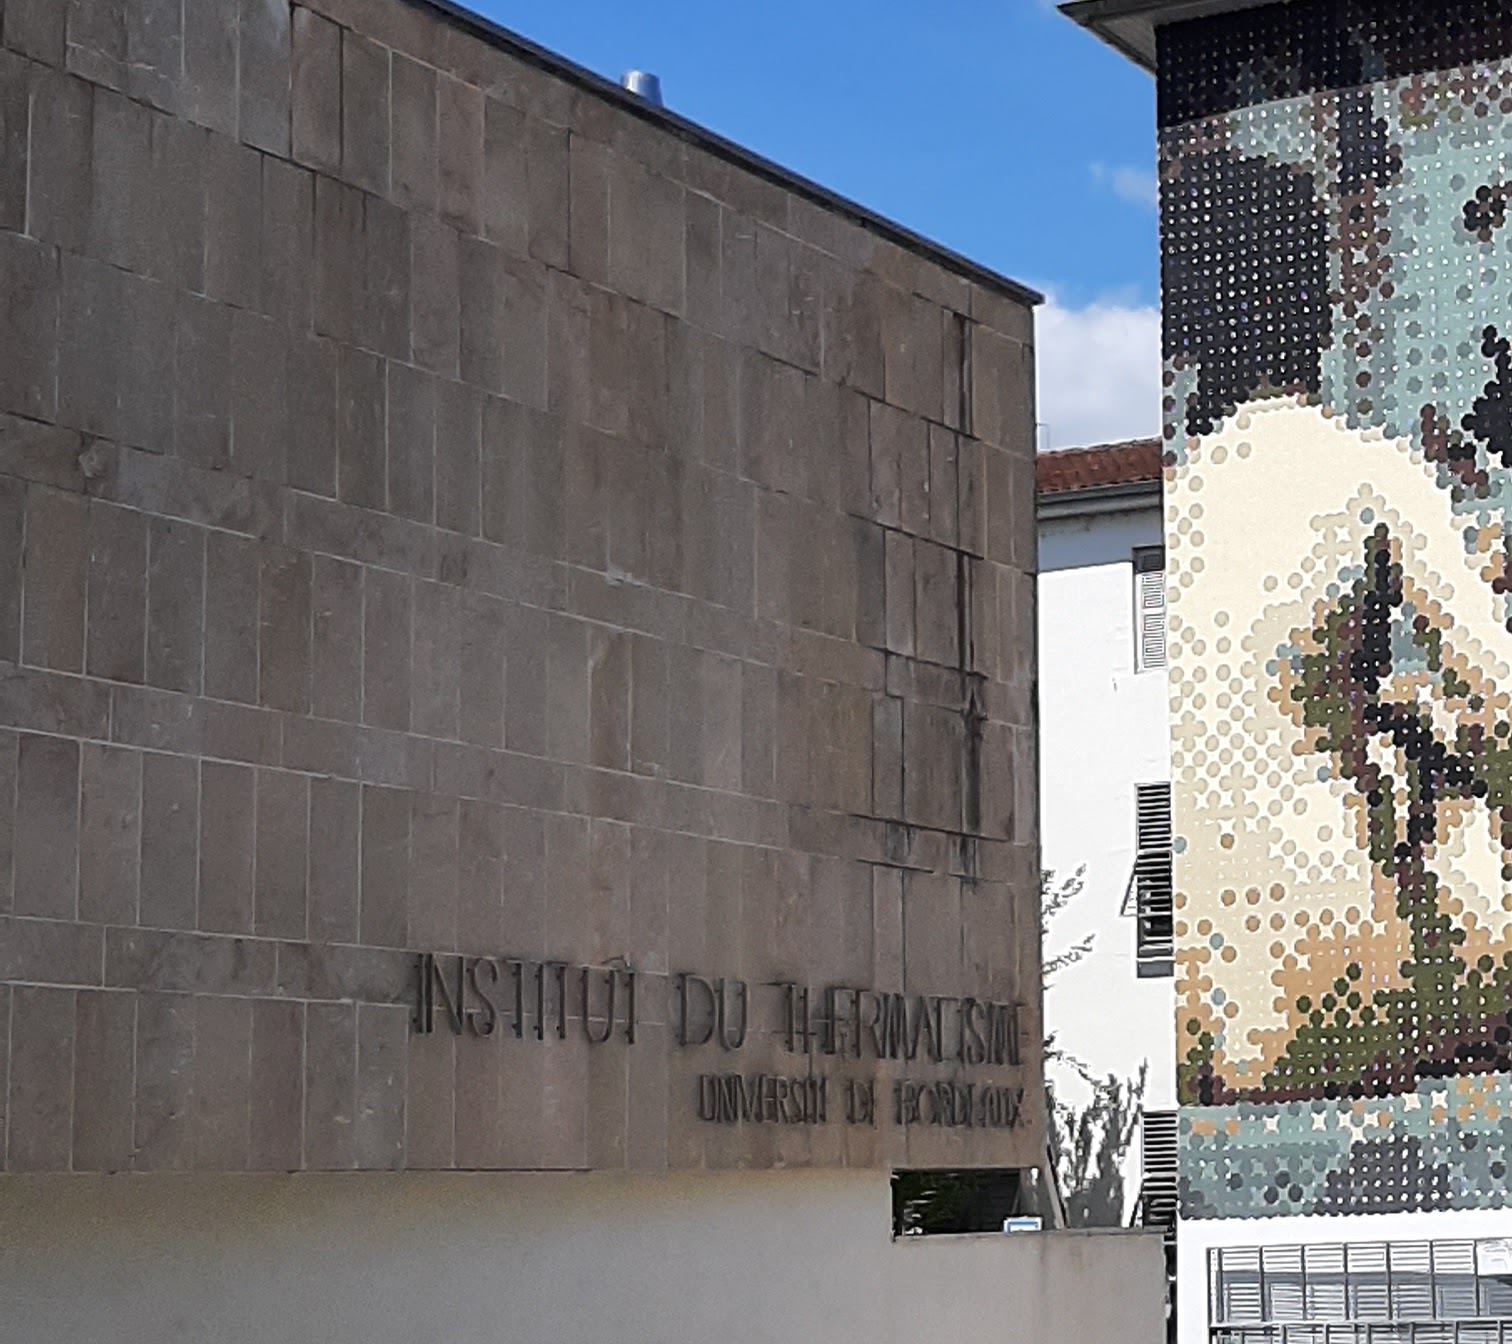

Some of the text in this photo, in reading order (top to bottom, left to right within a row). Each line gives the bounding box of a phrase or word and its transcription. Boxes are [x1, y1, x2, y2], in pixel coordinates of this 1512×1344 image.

[412, 951, 1027, 1067] INSTITUT DU THERMALISME
[893, 1079, 1029, 1129] BORDEAUX
